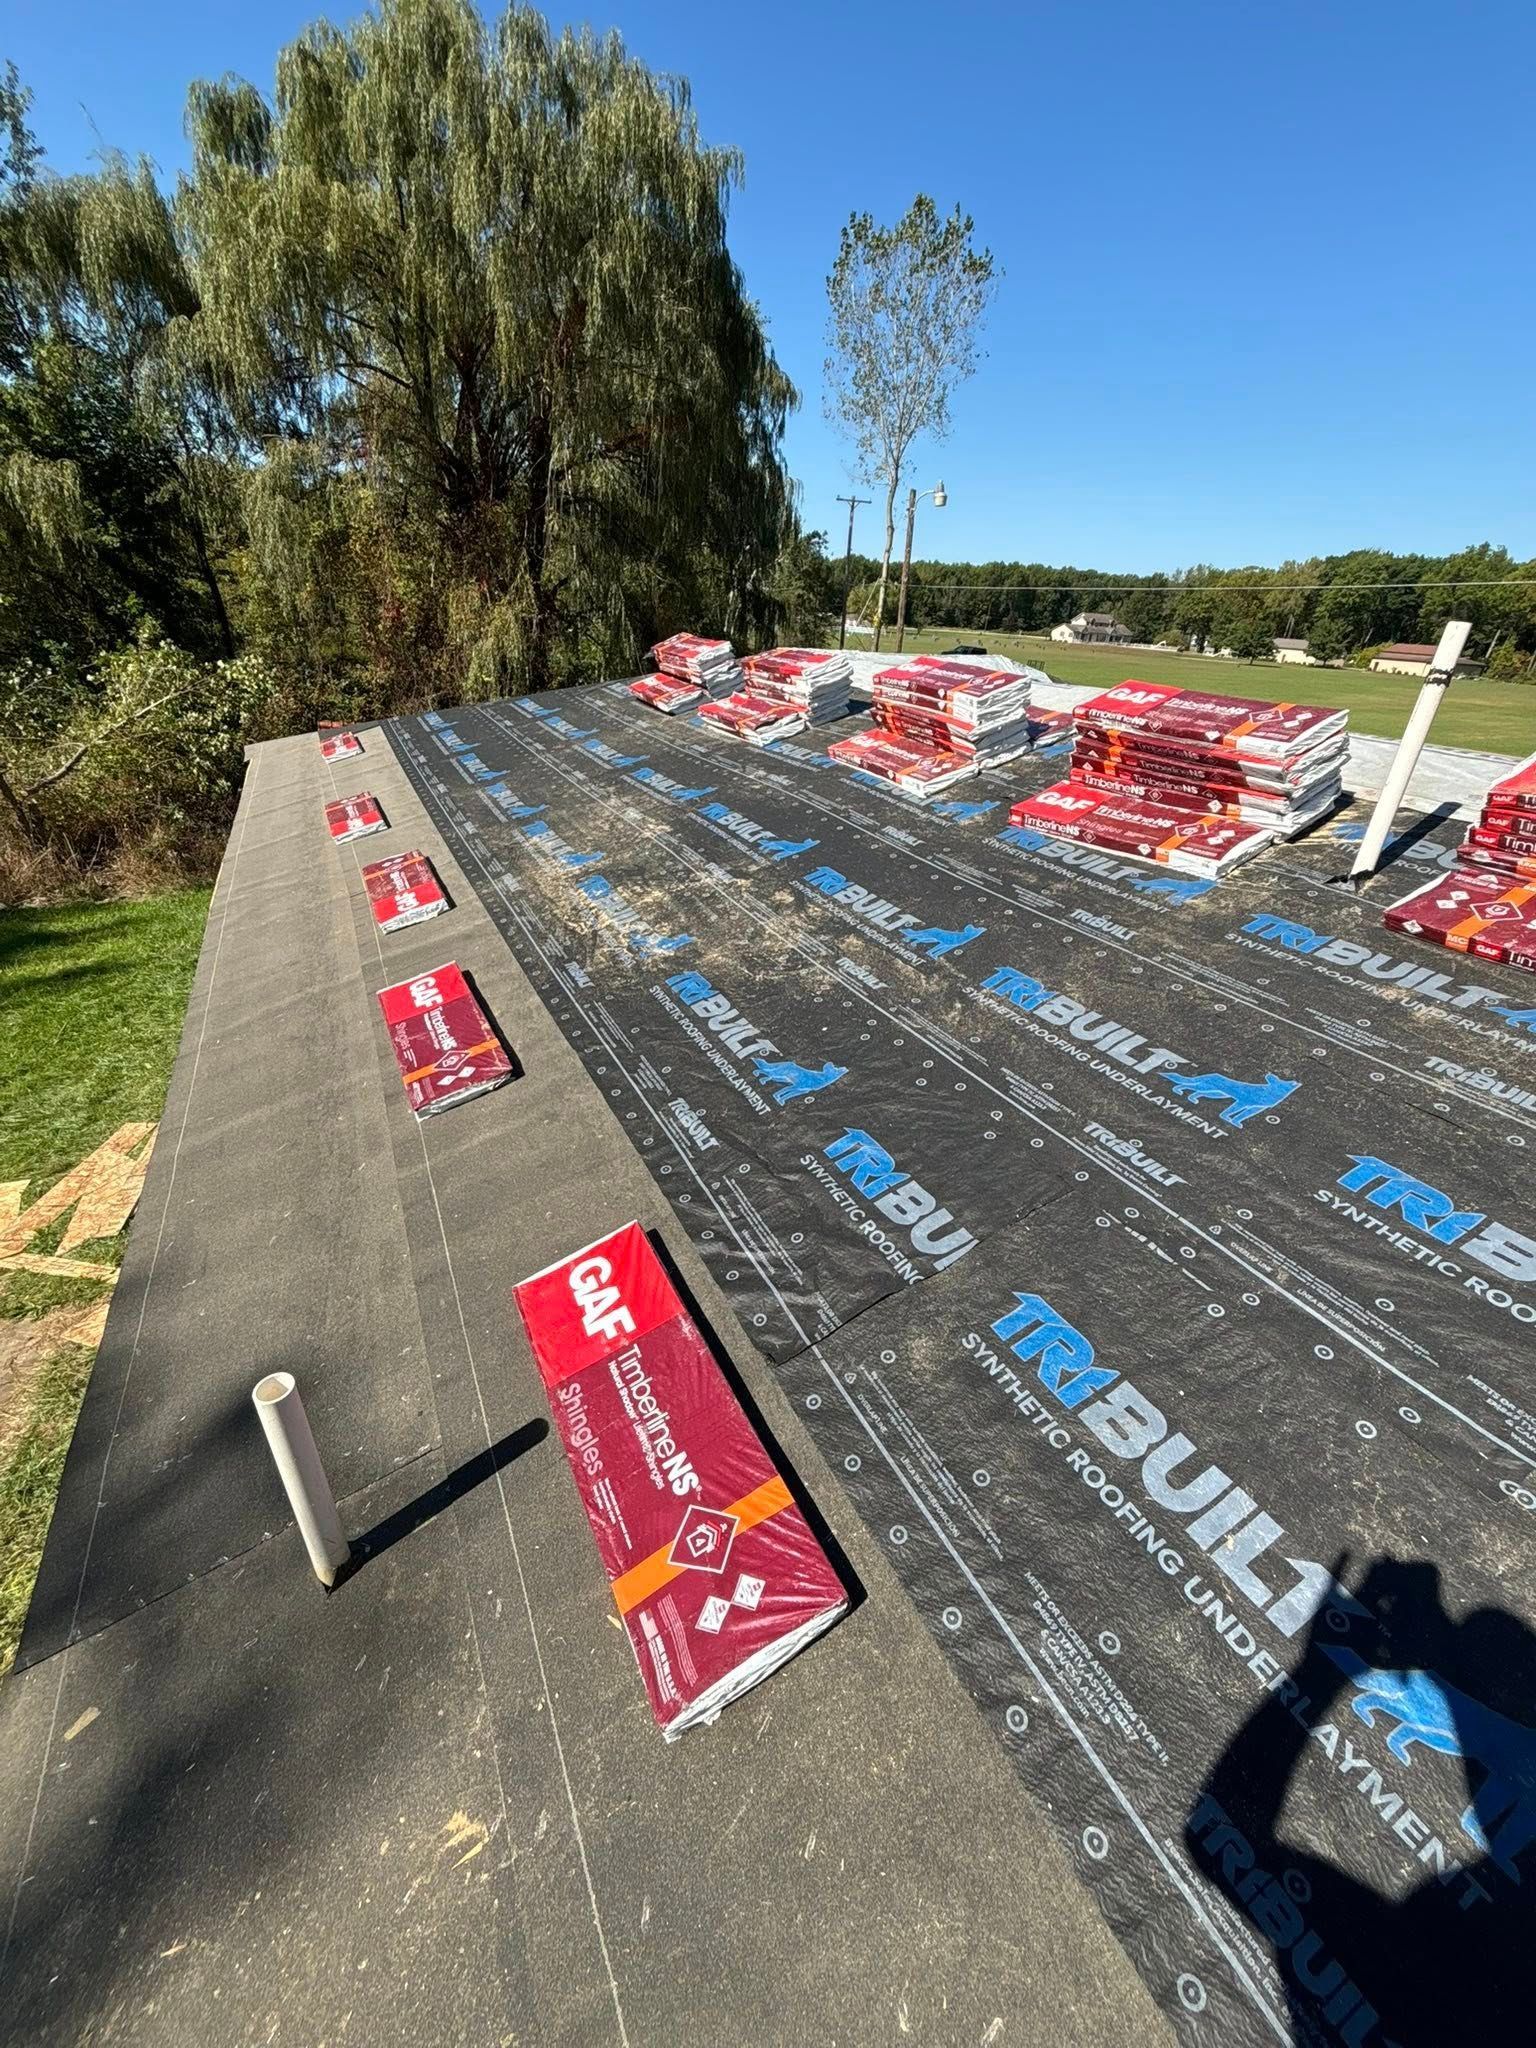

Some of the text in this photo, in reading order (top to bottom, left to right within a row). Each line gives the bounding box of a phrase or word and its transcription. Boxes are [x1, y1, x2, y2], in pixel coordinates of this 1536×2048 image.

[1106, 688, 1168, 704] GAF
[1036, 791, 1096, 811] GAF
[981, 837, 1030, 863] SYNTHETIC
[1028, 857, 1078, 881] ROOFING
[1077, 876, 1171, 914] UNDERLAYMENT
[1225, 932, 1314, 967] SYNTHETIC
[409, 977, 443, 1008] GAF
[649, 984, 684, 1020] SYNTHETIC
[678, 1017, 711, 1053] ROOFING
[706, 1049, 772, 1117] UNDERLAYMENT
[961, 986, 1030, 1027] SYNTHETIC
[1026, 1023, 1092, 1063] ROOFING
[1089, 1058, 1230, 1142] UNDERLAYMENT
[800, 1154, 867, 1222] SYNTHETIC
[1313, 1189, 1463, 1278] SYNTHETIC
[568, 1255, 637, 1340] GAF
[560, 1382, 604, 1476] Shingles
[961, 1332, 1071, 1450] SYNTHETIC
[1065, 1450, 1184, 1577] ROOFING
[1023, 1570, 1050, 1603] MEETS
[1045, 1600, 1062, 1617] OR
[1089, 1658, 1117, 1692] ASTM
[1053, 1628, 1079, 1659] TYPE
[1083, 1670, 1113, 1705] ASTM
